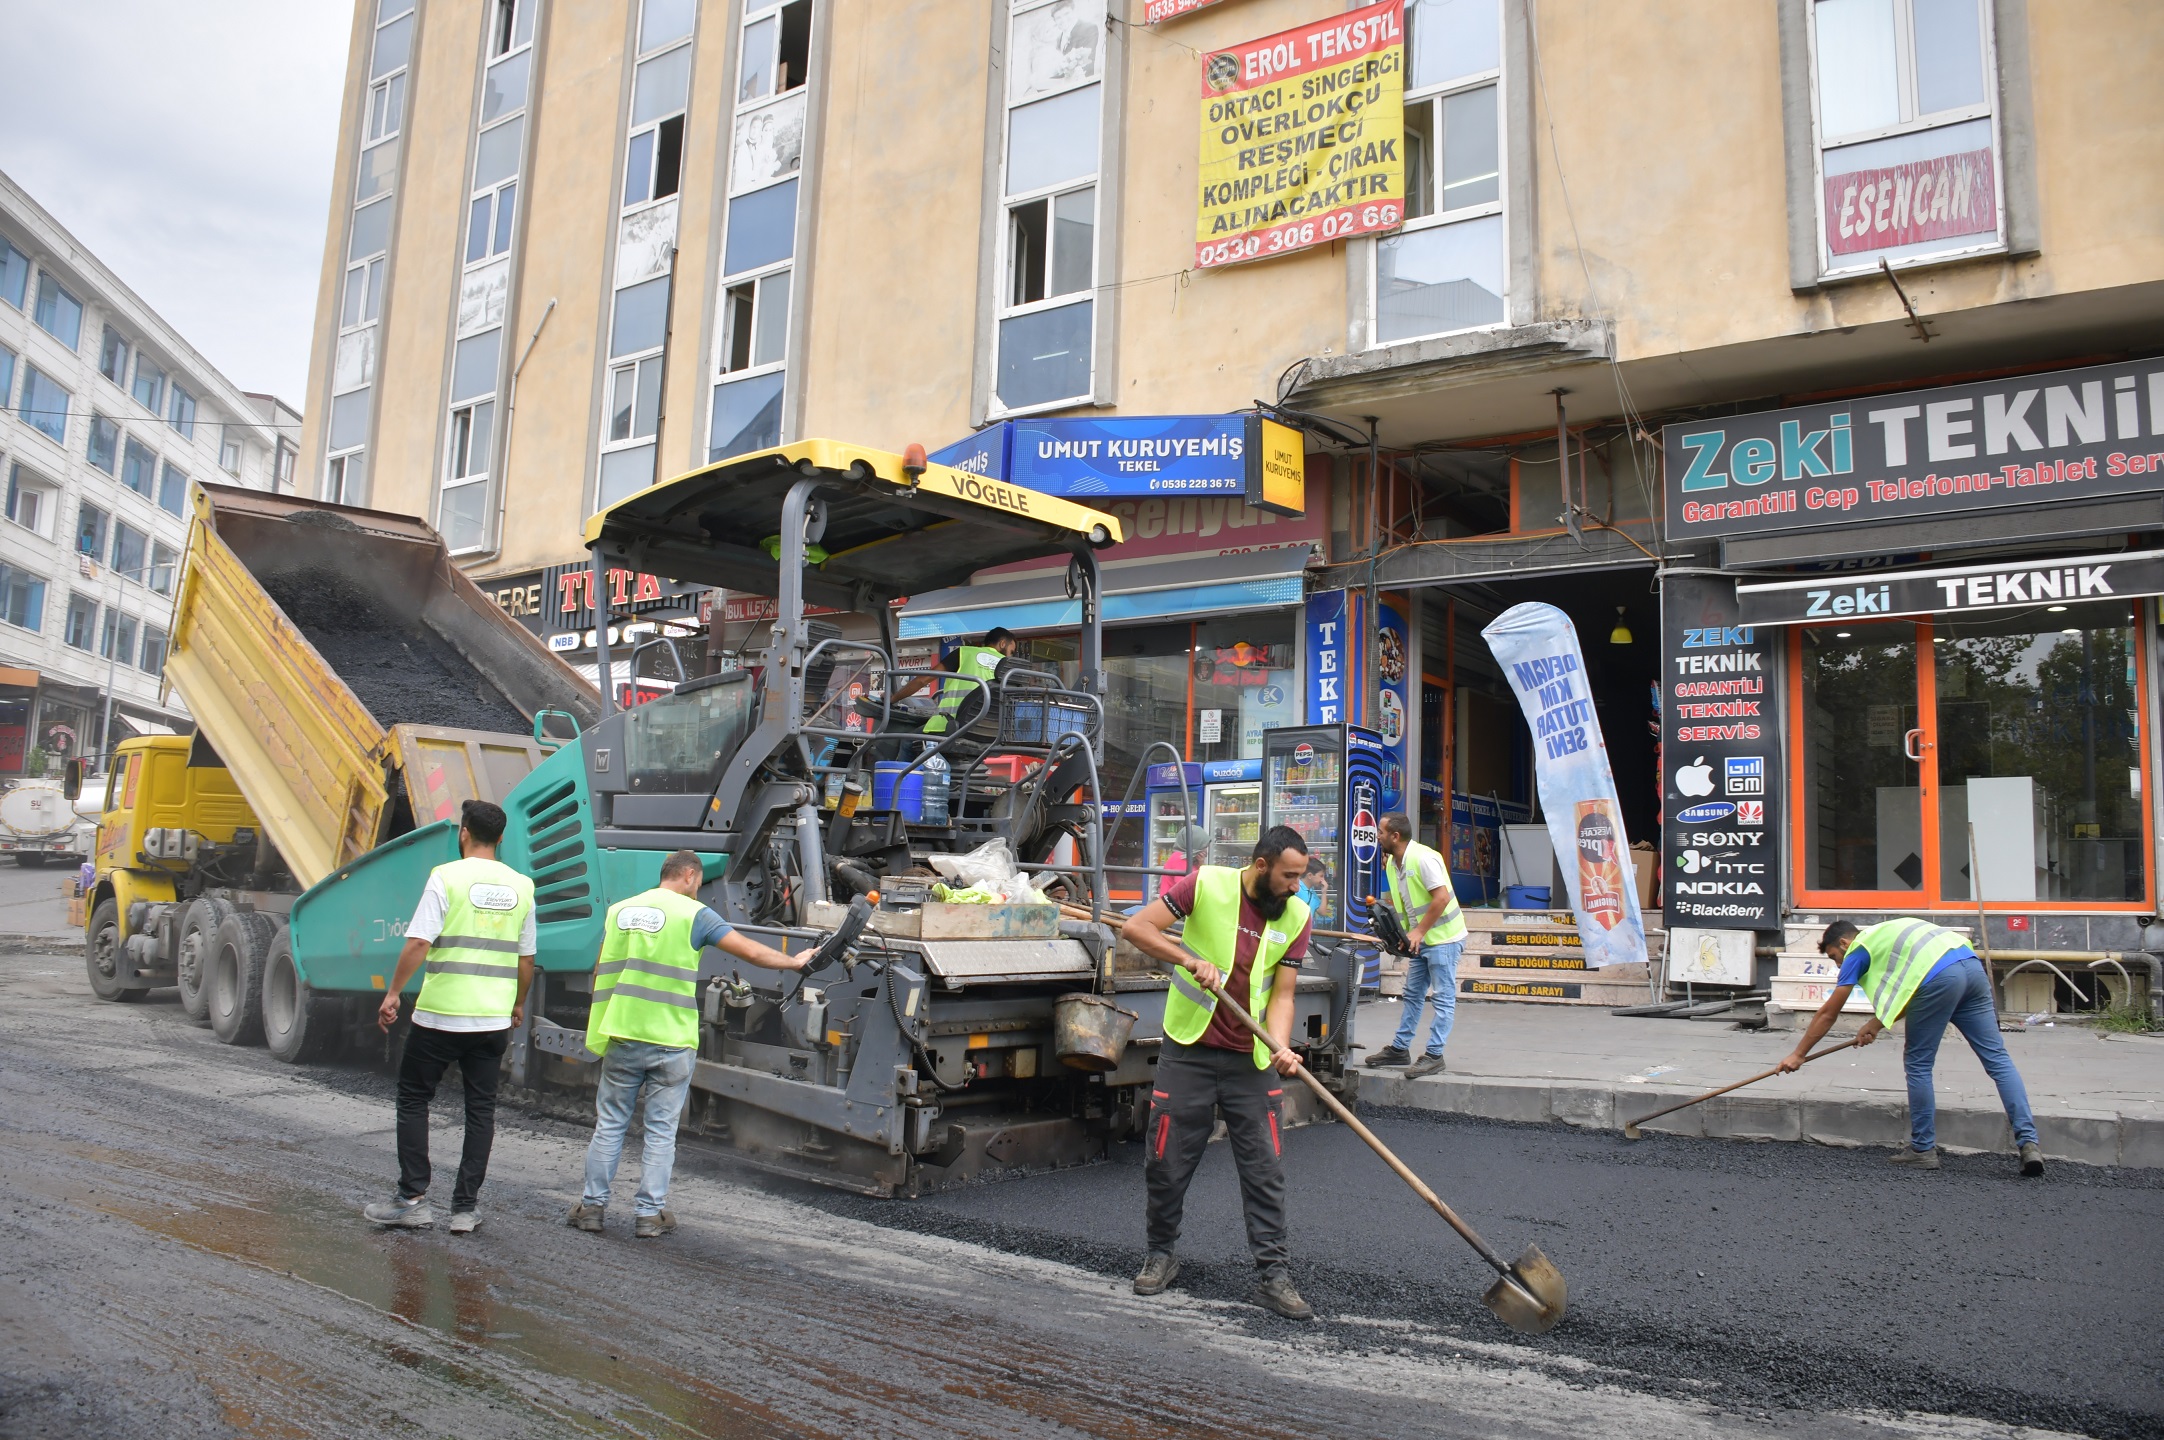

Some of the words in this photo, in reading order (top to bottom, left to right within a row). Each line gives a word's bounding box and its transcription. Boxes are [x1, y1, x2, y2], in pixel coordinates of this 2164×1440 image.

[1245, 43, 1301, 81] EROL
[1209, 86, 1282, 123] ORTACI
[1220, 83, 1381, 145] OVERLOKÇU
[1328, 138, 1397, 183] ÇIRAK
[1210, 173, 1389, 235] ALINACAKTIR
[1839, 166, 1973, 240] ESENCAN
[1200, 235, 1260, 266] 0530
[1268, 222, 1314, 252] 306
[1322, 212, 1353, 238] 02
[1362, 203, 1398, 228] 66
[1037, 440, 1102, 460] UMUT
[1107, 433, 1244, 461] KURUYEMİŞ
[1273, 448, 1293, 464] UMUT
[1681, 411, 1855, 494] Zeki
[1117, 459, 1161, 472] TEKEL
[1264, 460, 1302, 486] KURUYEMİŞ
[1161, 479, 1188, 490] 0536
[1188, 479, 1208, 489] 228
[1209, 478, 1223, 489] 36
[1223, 478, 1237, 488] 75
[1681, 489, 1798, 523] Garantili
[1804, 486, 1859, 512] Cep
[1865, 455, 2099, 504] Telefonu-Tablet
[950, 474, 1030, 514] VÖGELE
[1806, 585, 1891, 617] Zeki
[554, 636, 574, 648] NBB
[654, 637, 698, 660] Tenik
[653, 660, 695, 680] Seris
[898, 657, 926, 668] NYURT
[1318, 621, 1339, 724] TEKE
[1246, 730, 1264, 738] AYRA
[1729, 777, 1760, 792] GM
[1684, 808, 1730, 817] SAMSUNG
[1353, 829, 1376, 843] PEPSI
[1692, 832, 1764, 847] SONY
[1676, 881, 1764, 895] NOKIA
[1508, 915, 1536, 925] ESEN
[1691, 903, 1764, 920] BlackBerry
[1506, 934, 1528, 944] ESEN
[1561, 935, 1583, 946] SARA
[1495, 957, 1517, 967] ESEN
[1551, 959, 1584, 969] SARAYI
[1472, 982, 1495, 992] ESEN
[1530, 986, 1564, 997] SARAYI
